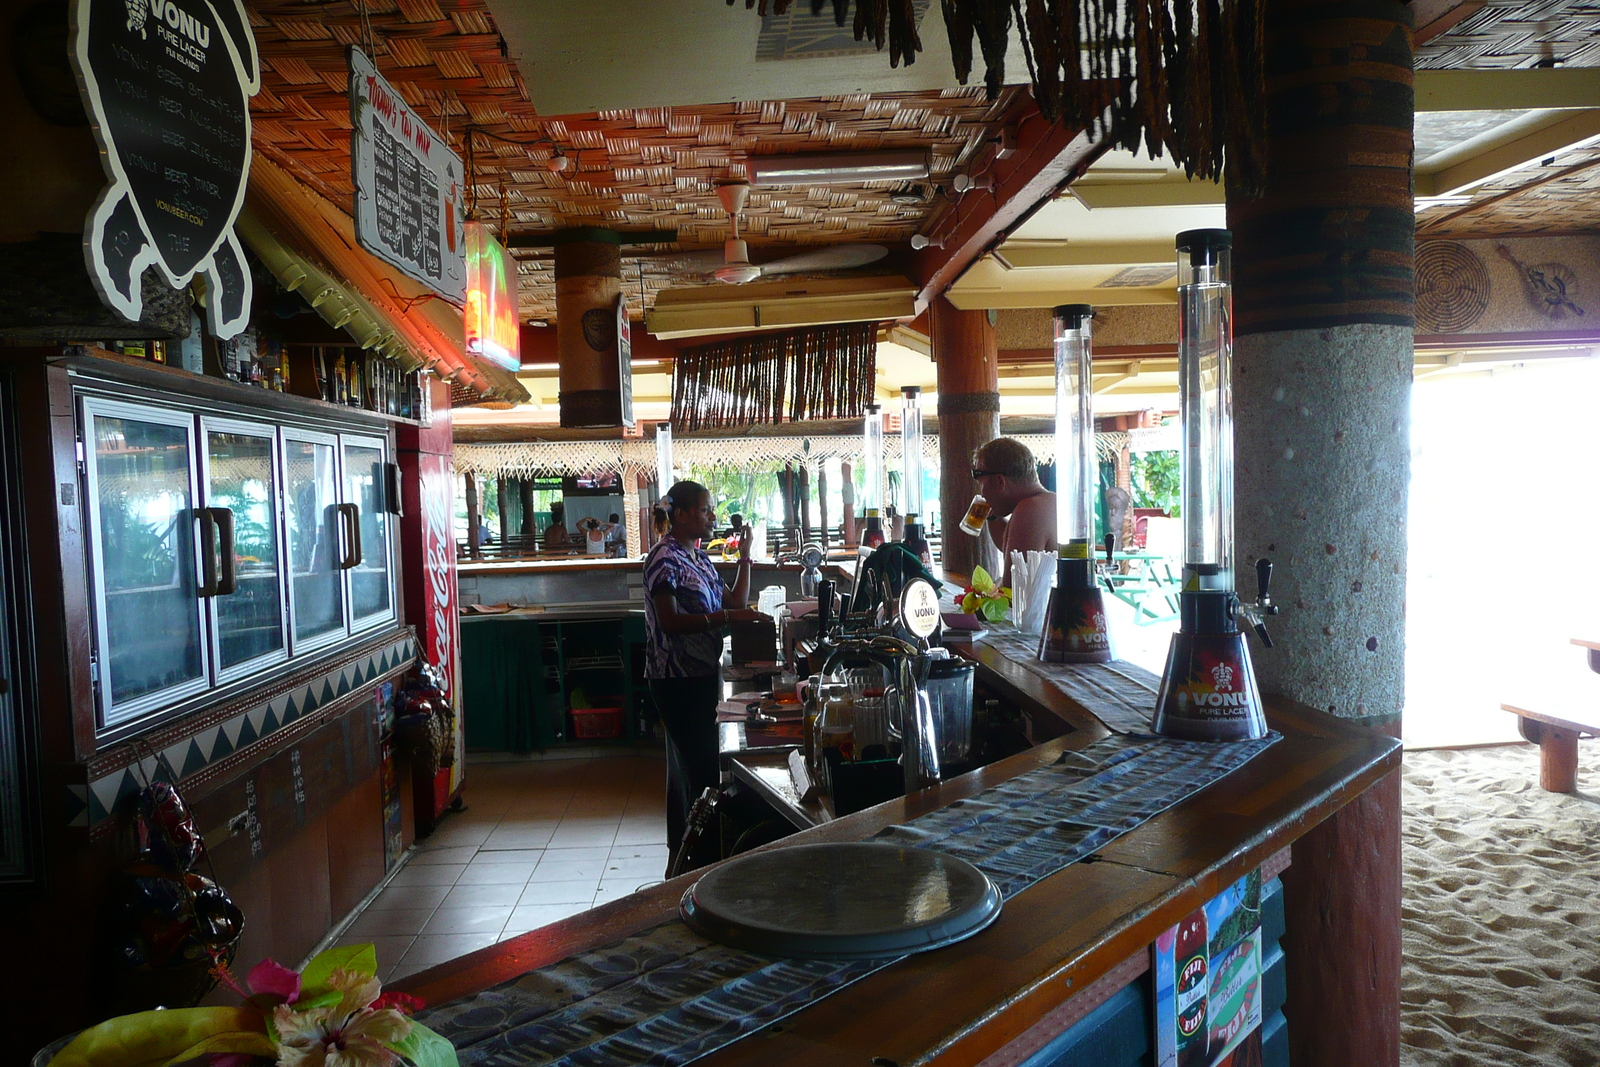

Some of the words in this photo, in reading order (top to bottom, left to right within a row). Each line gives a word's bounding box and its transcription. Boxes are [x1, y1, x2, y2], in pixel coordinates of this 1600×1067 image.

[150, 0, 211, 49] VONU
[157, 24, 180, 48] PURE
[179, 38, 208, 64] LAGER
[165, 46, 176, 60] FIJI
[176, 52, 200, 73] ISLANDS
[156, 64, 185, 89] BEER
[366, 75, 397, 128] TODAY'S
[415, 124, 431, 160] MIX
[164, 166, 191, 187] BEER
[155, 198, 205, 227] VONUBEER.COM
[426, 487, 449, 692] oca-Cola
[914, 607, 935, 618] VONU
[1082, 632, 1109, 643] VON
[1192, 691, 1249, 707] VONU
[1199, 708, 1221, 716] PURE
[1184, 959, 1201, 981] FIJI
[1219, 944, 1243, 976] FIJI
[1184, 1009, 1202, 1032] FIJI
[1217, 1001, 1248, 1042] FIJI
